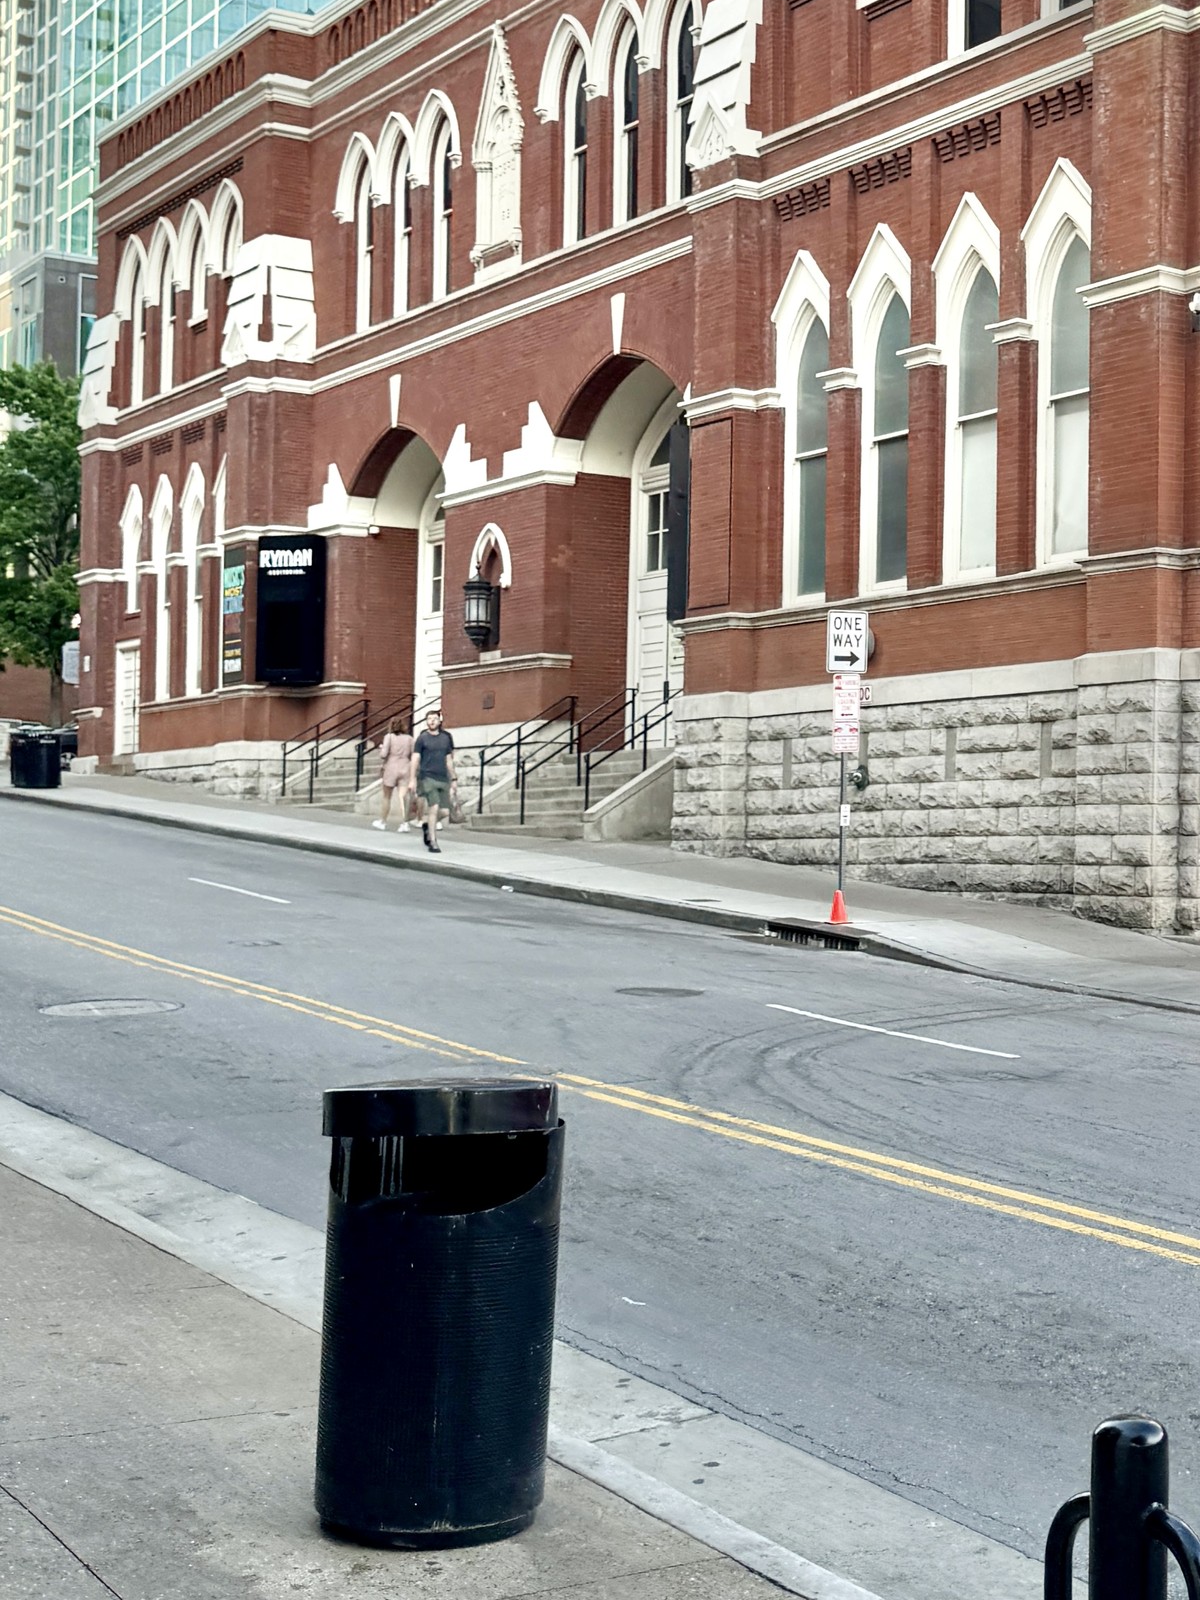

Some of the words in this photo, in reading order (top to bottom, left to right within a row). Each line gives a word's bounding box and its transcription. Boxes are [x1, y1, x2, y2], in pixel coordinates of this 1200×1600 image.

[260, 549, 312, 568] RYMAN
[834, 617, 862, 631] ONE
[833, 634, 863, 648] WAY
